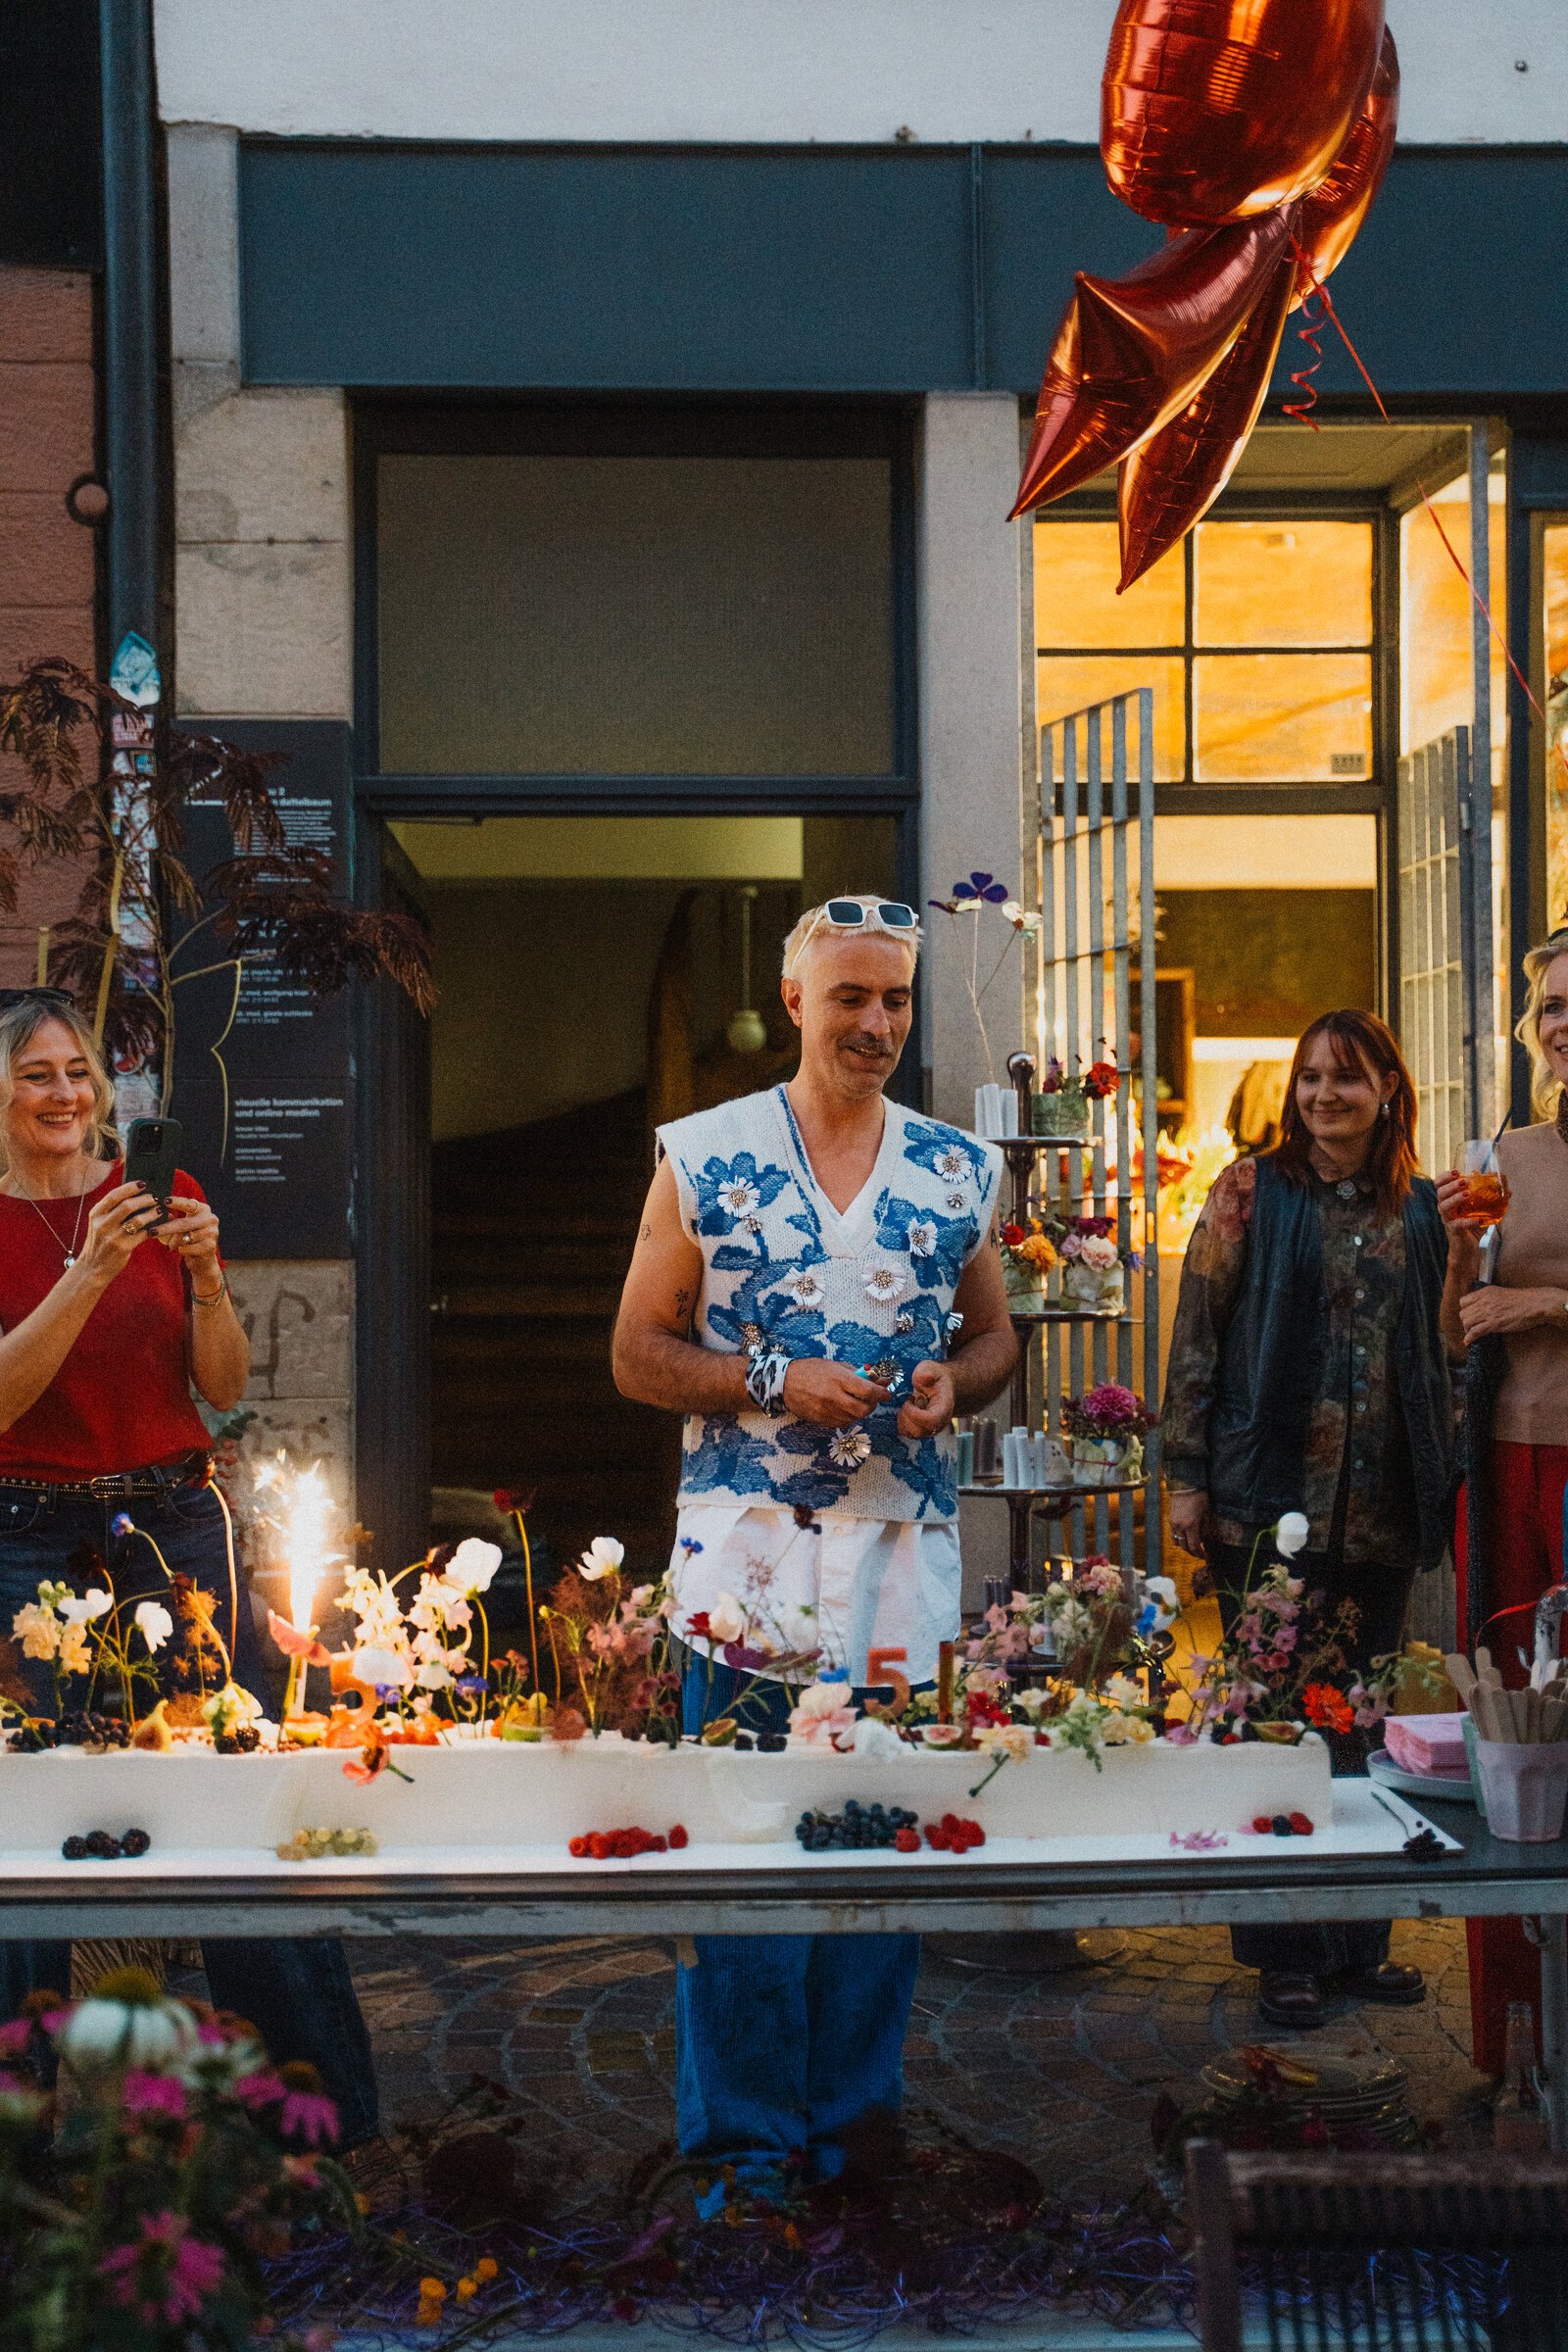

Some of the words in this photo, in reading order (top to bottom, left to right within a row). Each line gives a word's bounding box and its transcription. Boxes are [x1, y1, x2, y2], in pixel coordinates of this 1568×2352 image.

[234, 1099, 270, 1107] visuelle
[272, 1098, 344, 1107] kommunikation
[255, 1108, 283, 1117] online
[285, 1108, 320, 1117] medien
[863, 1646, 911, 1719] 5
